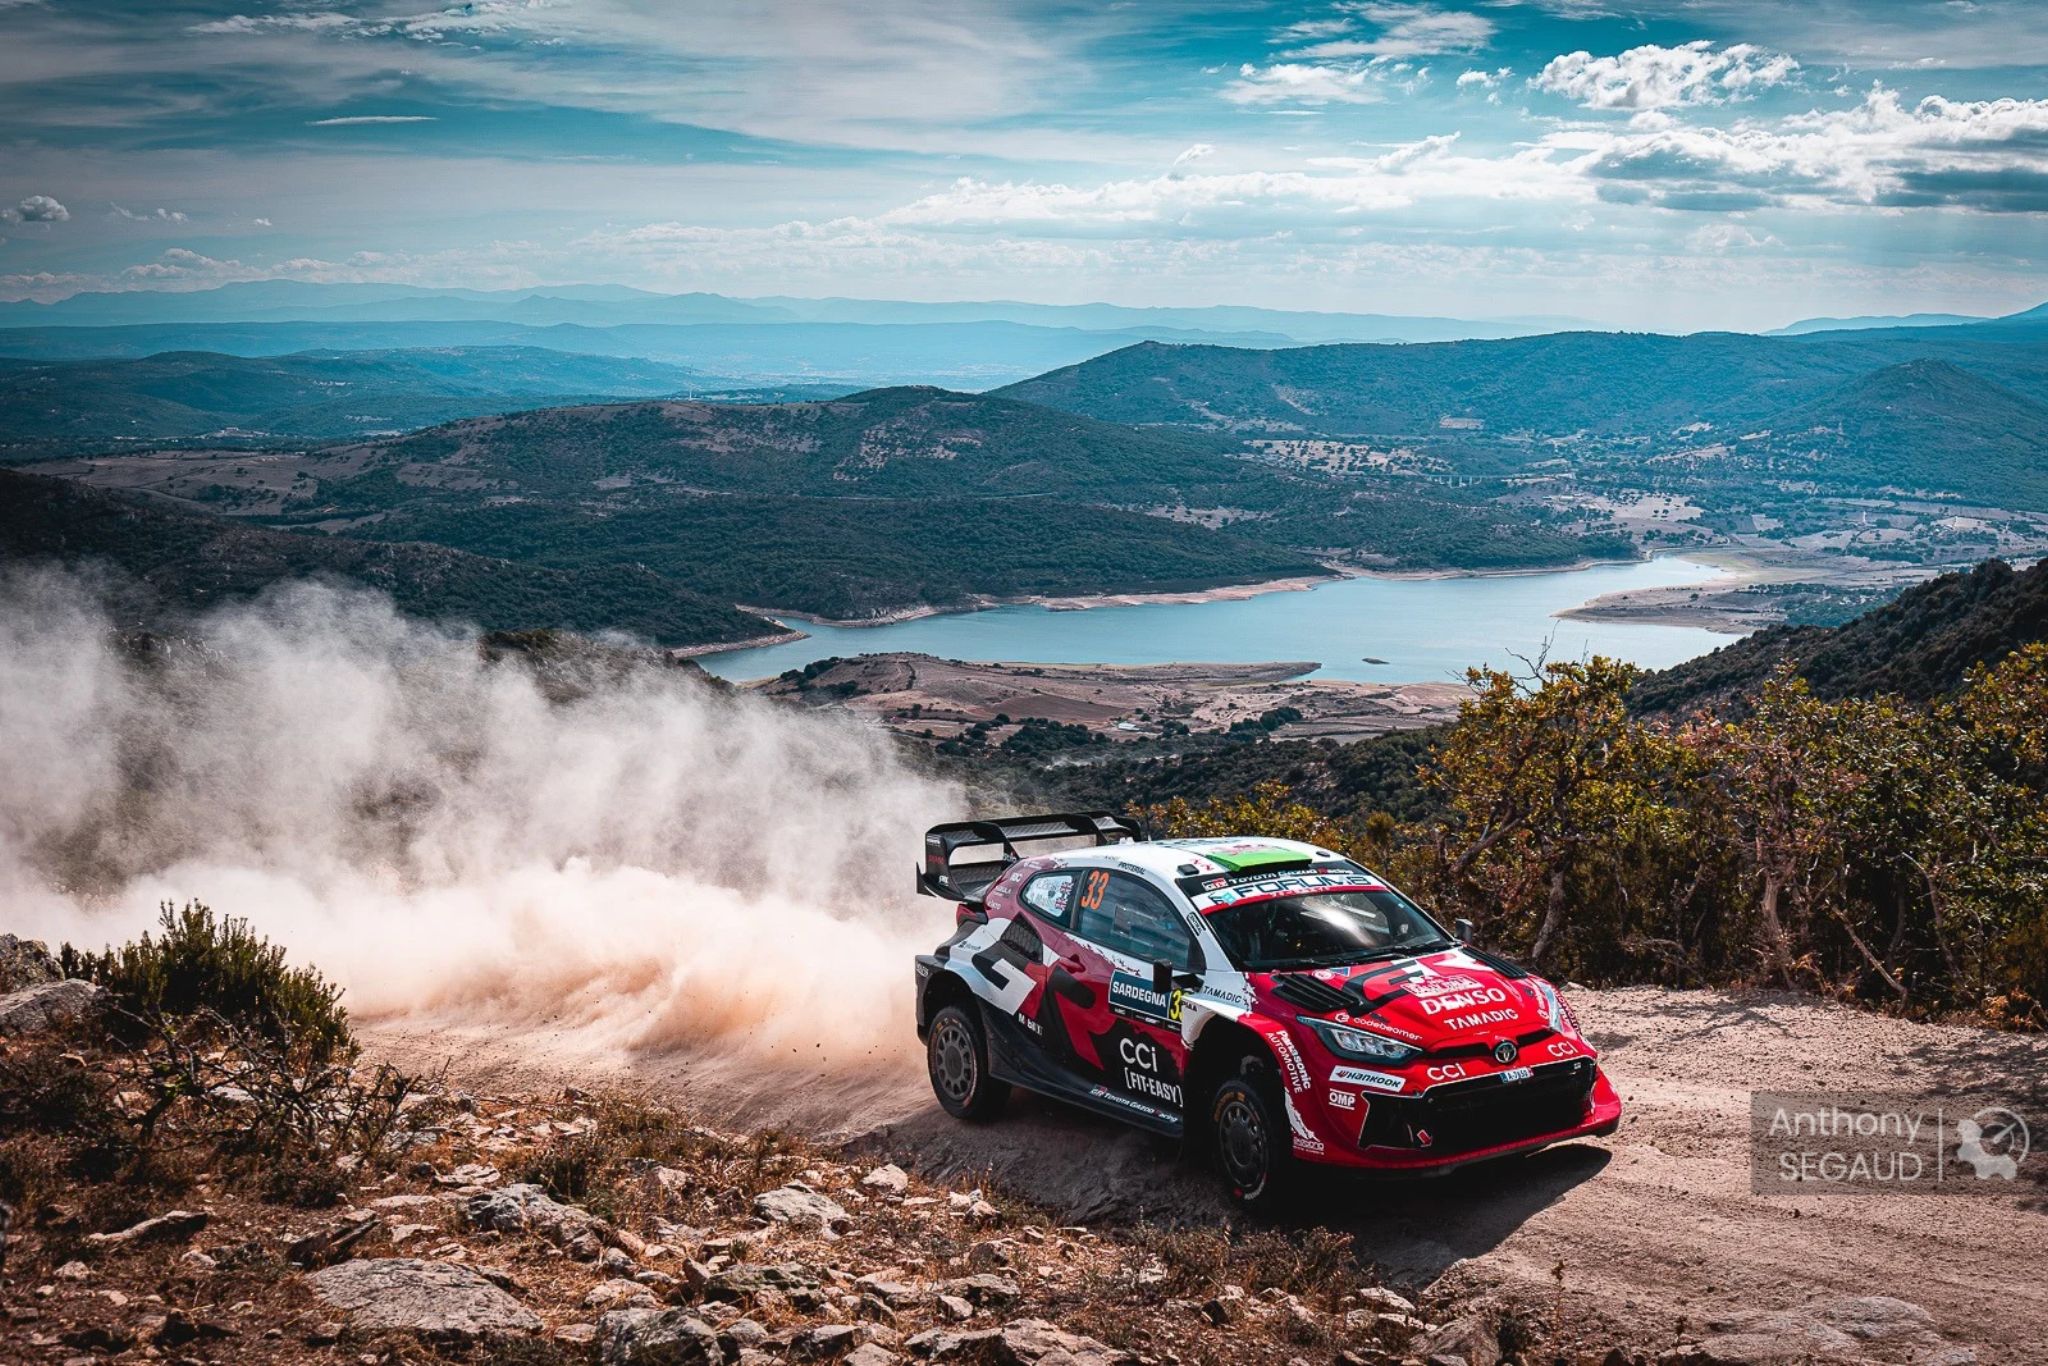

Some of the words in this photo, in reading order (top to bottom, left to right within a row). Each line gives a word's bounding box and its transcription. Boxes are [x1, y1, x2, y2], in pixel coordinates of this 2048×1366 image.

[1081, 869, 1110, 911] 33
[1229, 873, 1276, 885] TOYOTA
[1112, 981, 1167, 1008] SARDEGNA
[1170, 989, 1188, 1022] 3
[1203, 986, 1243, 1003] TAMADIC
[1419, 988, 1506, 1015] DENSO
[1353, 1017, 1420, 1041] codebeamer
[1444, 1008, 1520, 1030] TAMADIC
[1265, 1032, 1303, 1094] AUTOMOTIVE
[1276, 1029, 1312, 1090] Panasonic
[1329, 1091, 1356, 1107] OMP
